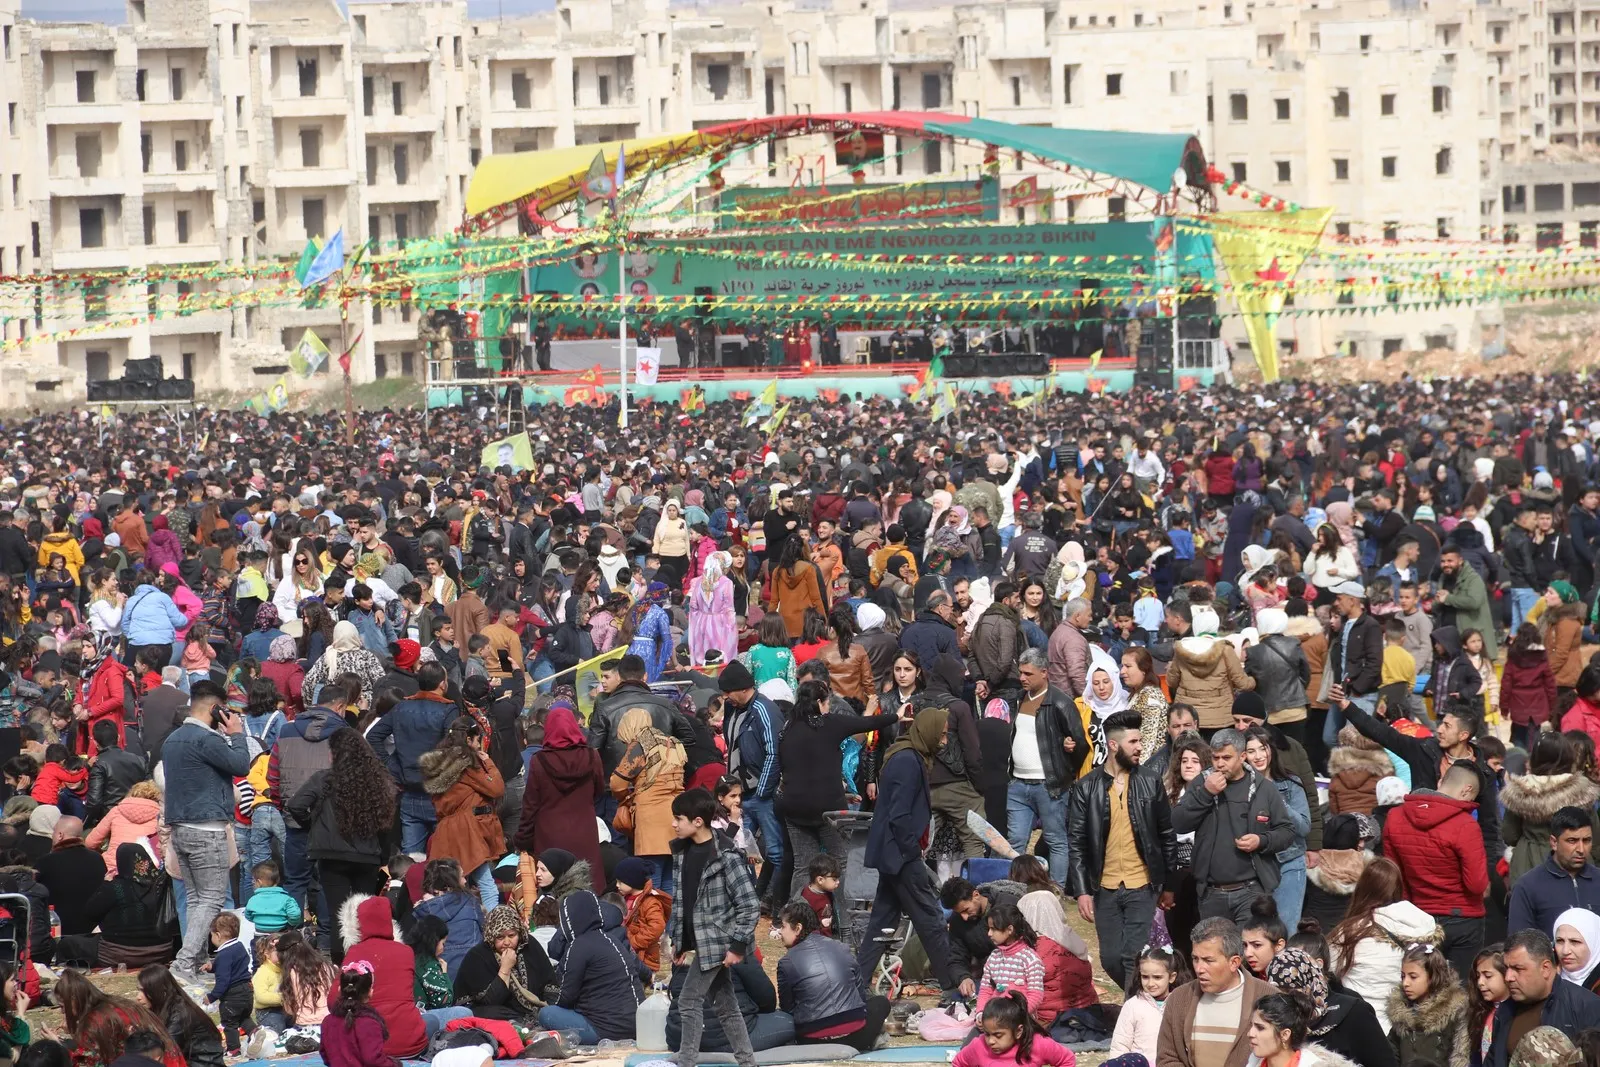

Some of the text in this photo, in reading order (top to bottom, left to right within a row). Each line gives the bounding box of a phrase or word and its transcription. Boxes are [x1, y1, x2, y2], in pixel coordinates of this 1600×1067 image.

[763, 238, 829, 251] GELAN
[881, 233, 983, 249] NEWROZA
[988, 232, 1036, 245] 2022
[1041, 230, 1096, 244] BIKIN
[720, 280, 754, 294] APO
[800, 278, 831, 294] حرية
[834, 277, 865, 293] نوروز
[905, 276, 935, 292] نوروز
